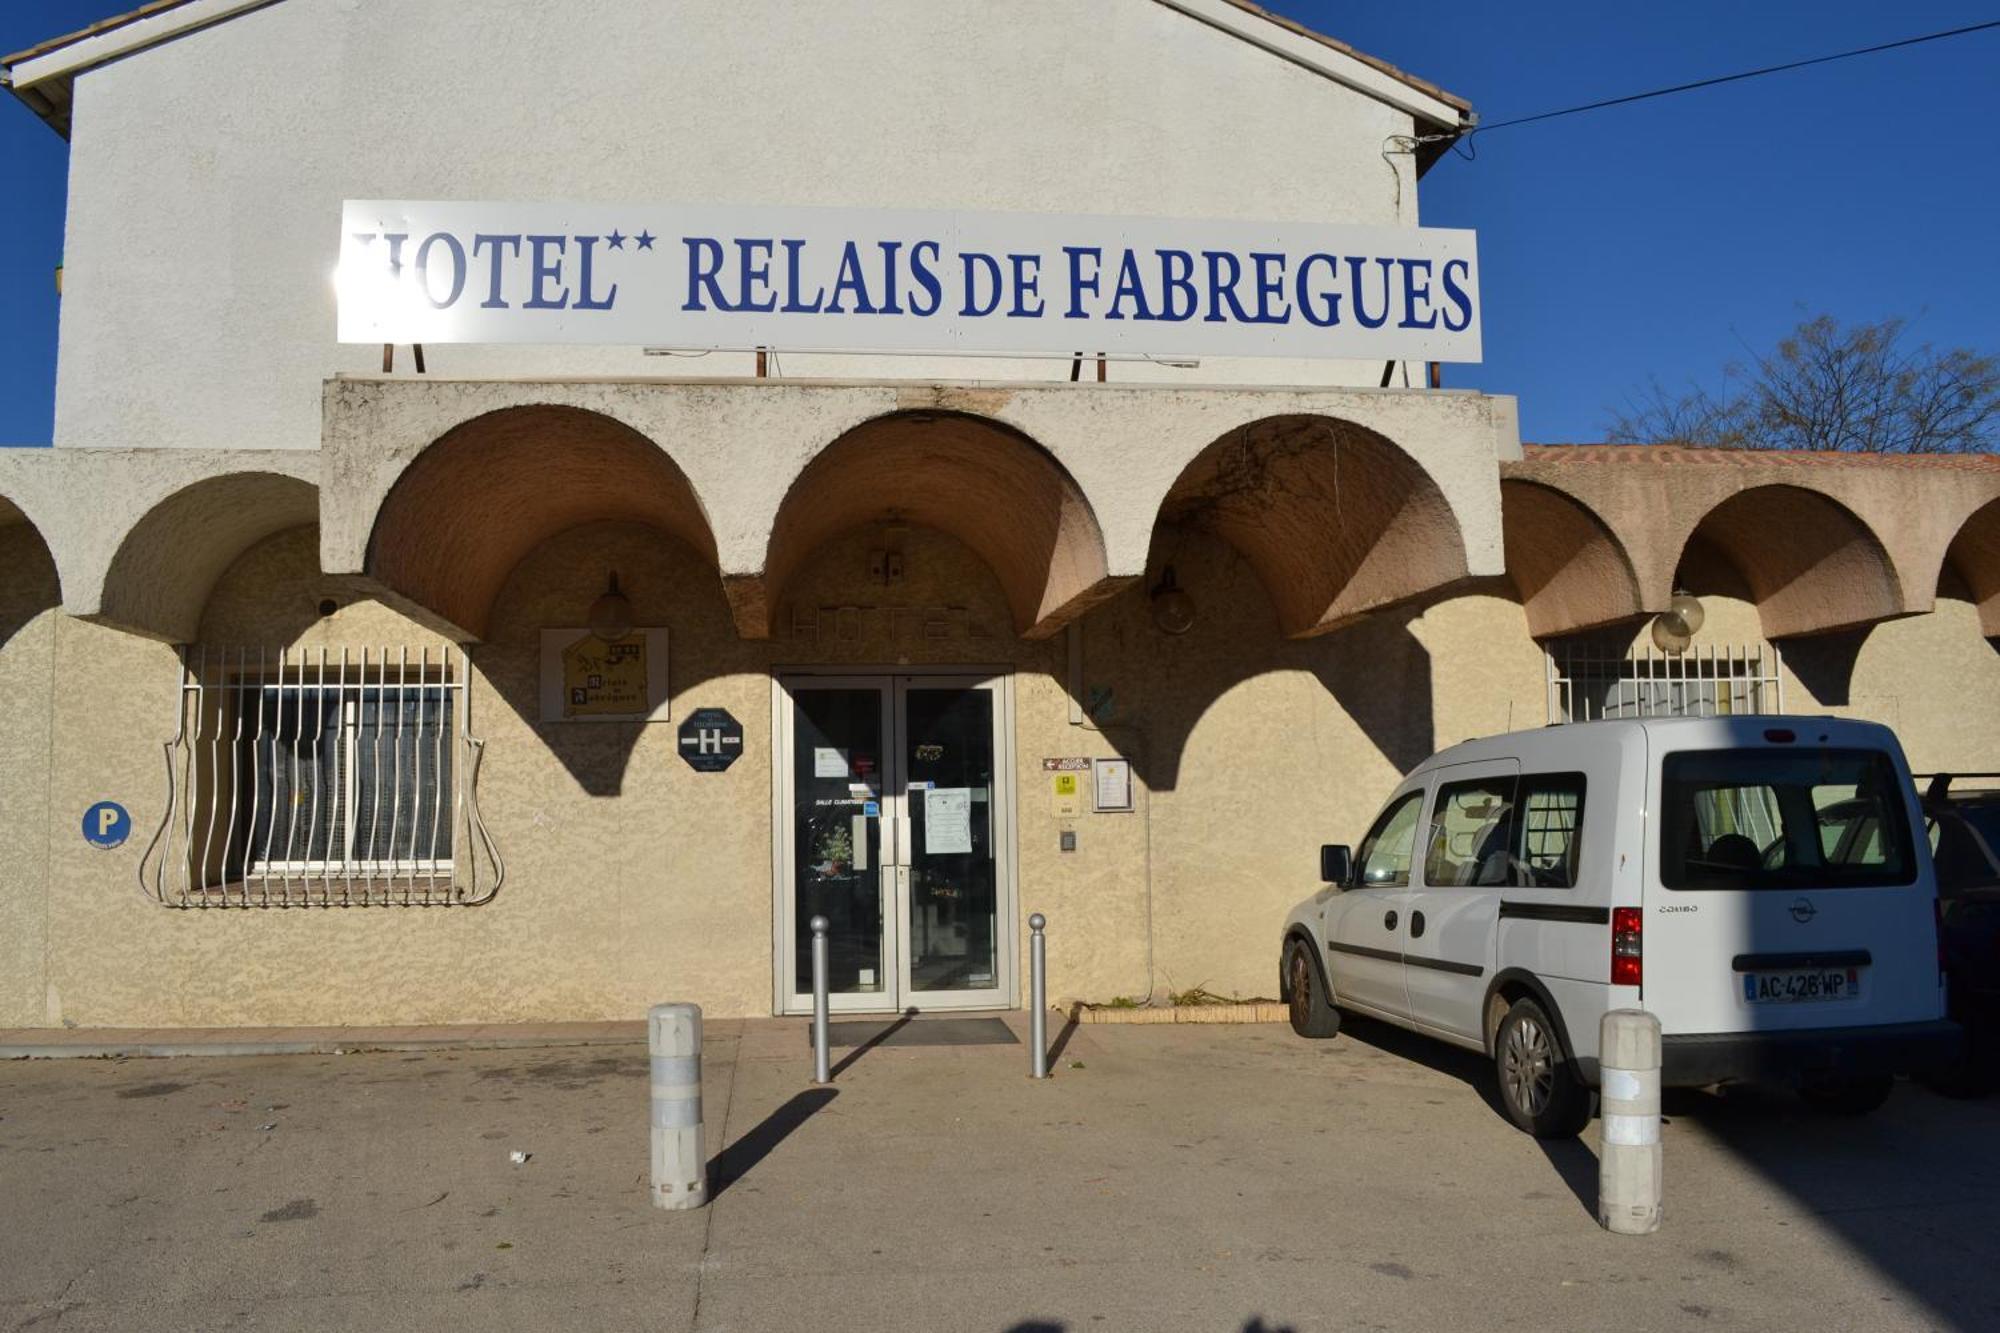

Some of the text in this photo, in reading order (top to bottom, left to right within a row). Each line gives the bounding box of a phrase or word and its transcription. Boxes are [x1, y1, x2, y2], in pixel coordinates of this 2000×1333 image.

[681, 236, 942, 317] RELAIS
[958, 252, 1045, 318] DE
[1062, 246, 1473, 332] FABREGUES
[699, 729, 721, 754] H
[99, 808, 119, 835] P
